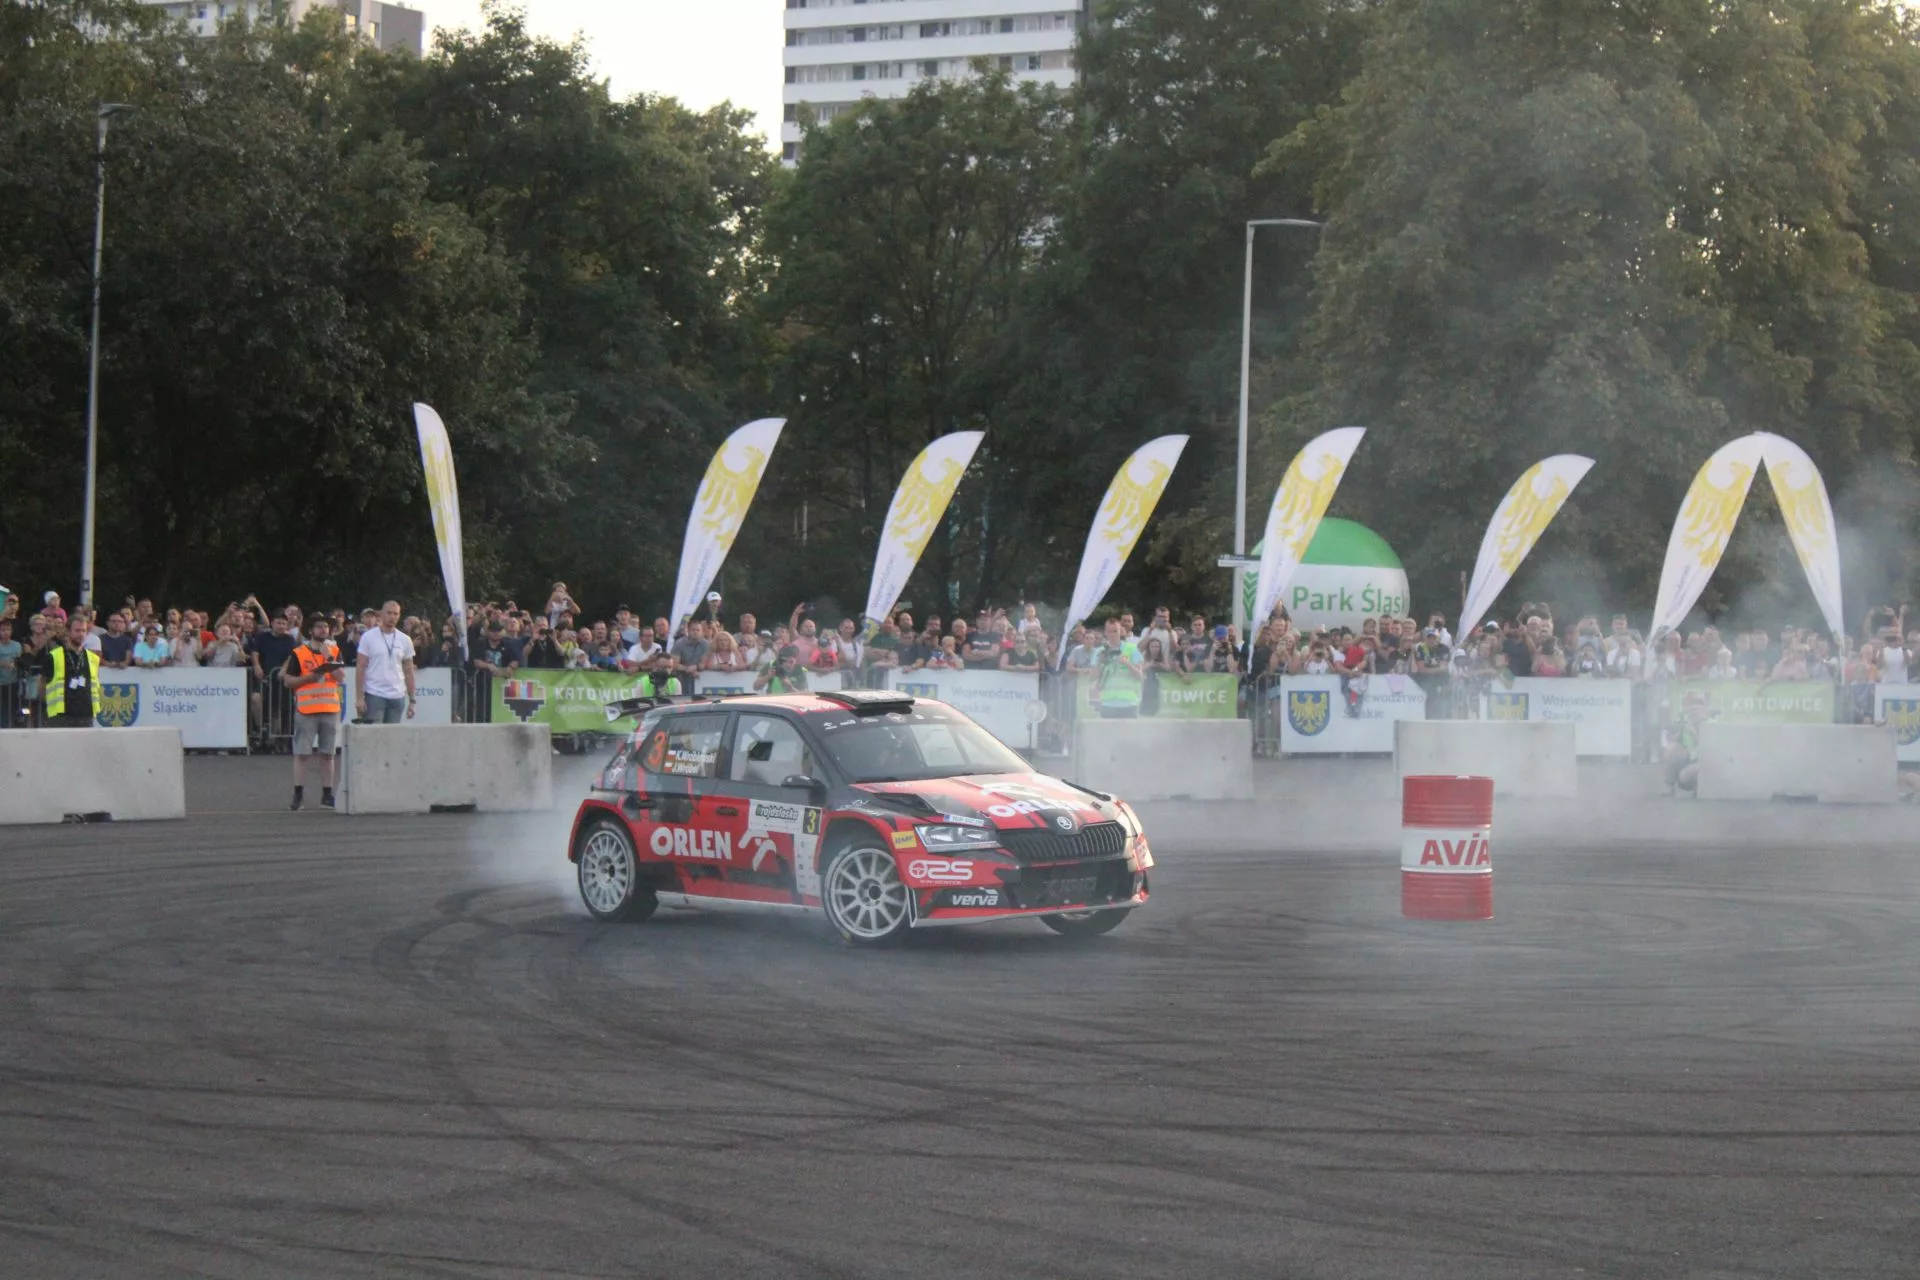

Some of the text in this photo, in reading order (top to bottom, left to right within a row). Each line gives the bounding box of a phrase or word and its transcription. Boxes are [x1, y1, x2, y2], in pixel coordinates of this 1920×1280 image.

[1292, 586, 1353, 612] Park
[152, 685, 240, 699] Województwo
[1161, 689, 1228, 704] TOWICE
[152, 700, 198, 716] Śląskie
[647, 730, 668, 767] 3
[807, 809, 818, 834] 3
[650, 826, 733, 860] ORLEN
[951, 893, 999, 906] verva
